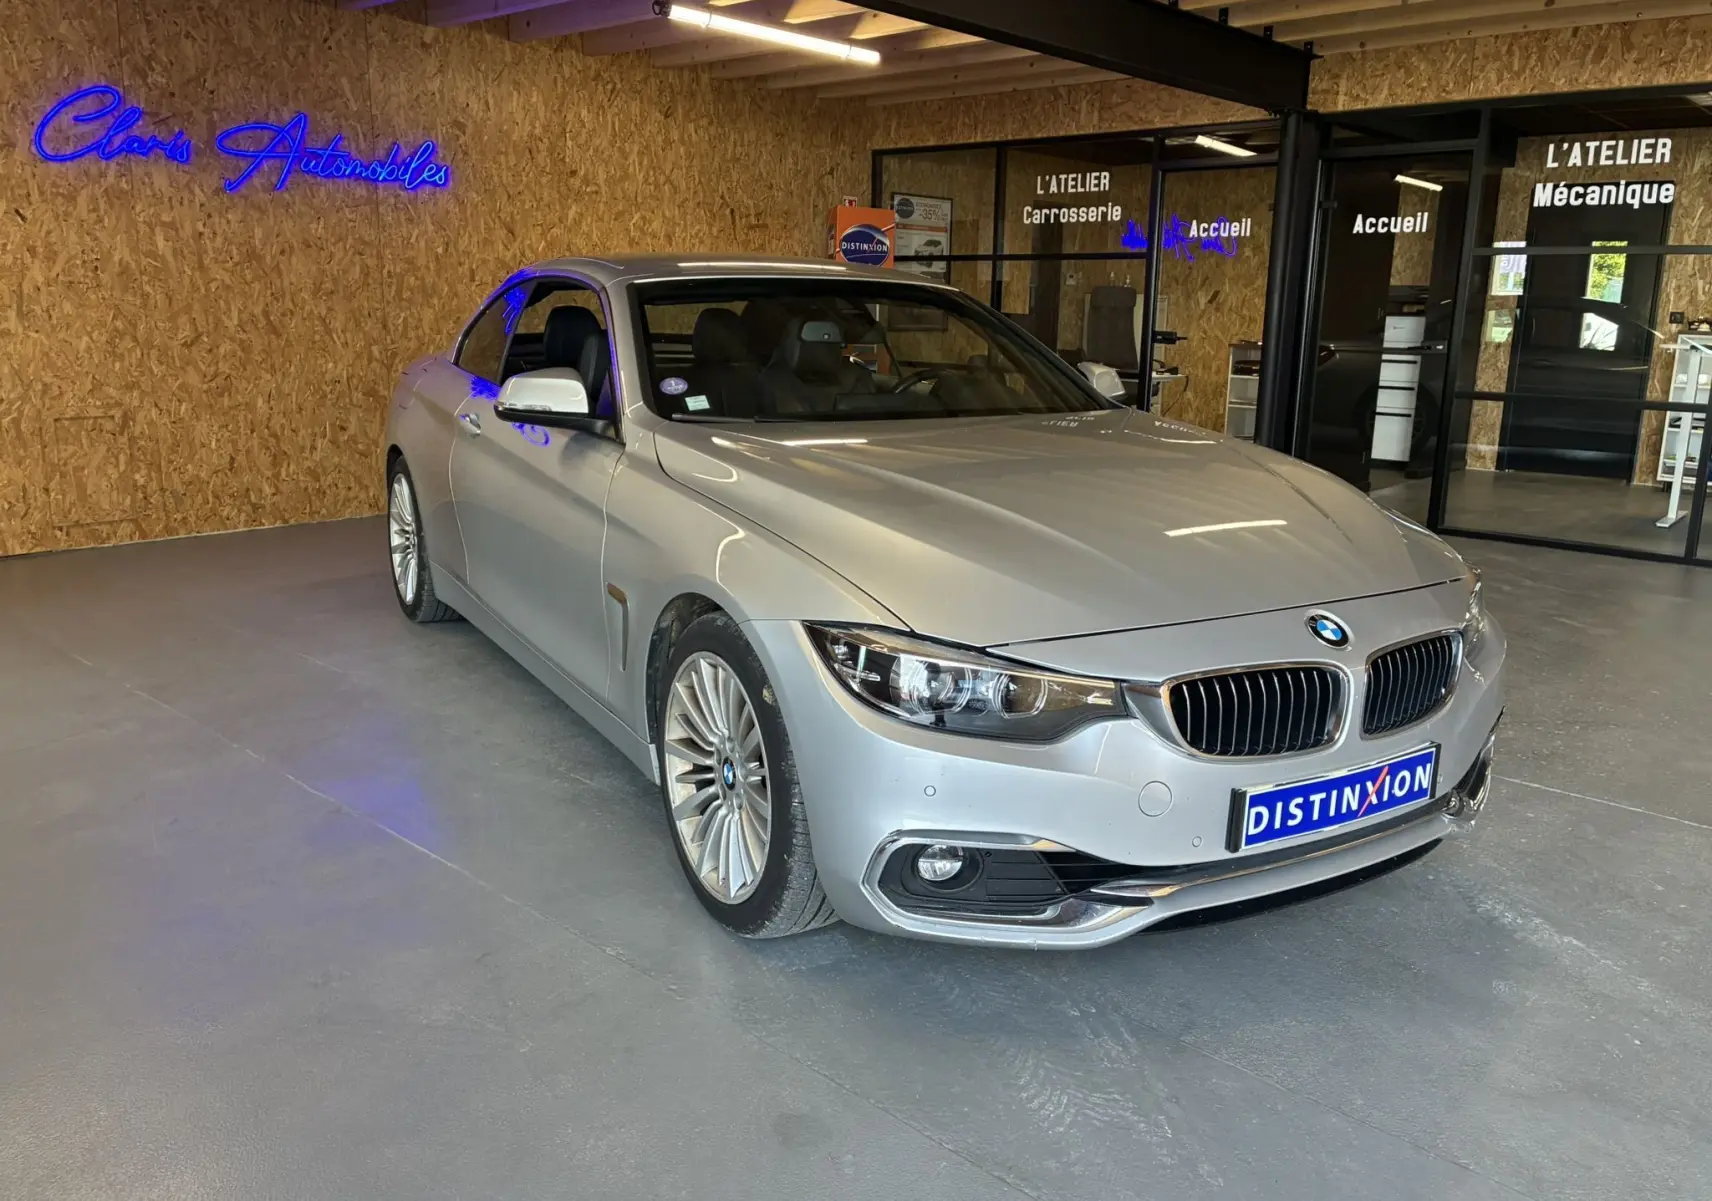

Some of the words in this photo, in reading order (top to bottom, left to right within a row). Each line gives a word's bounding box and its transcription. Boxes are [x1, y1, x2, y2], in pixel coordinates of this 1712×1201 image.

[35, 85, 191, 164] Claris
[216, 113, 449, 192] Automobiles
[1546, 138, 1672, 168] L'ATELIER
[1037, 171, 1110, 194] L'ATELIER
[1533, 180, 1675, 209] Mécanique
[1023, 203, 1122, 224] Carrosserie
[1352, 212, 1429, 234] Accueil
[1189, 218, 1251, 238] Accueil
[841, 240, 888, 252] DISTINXION
[1247, 763, 1432, 836] DISTINXION
